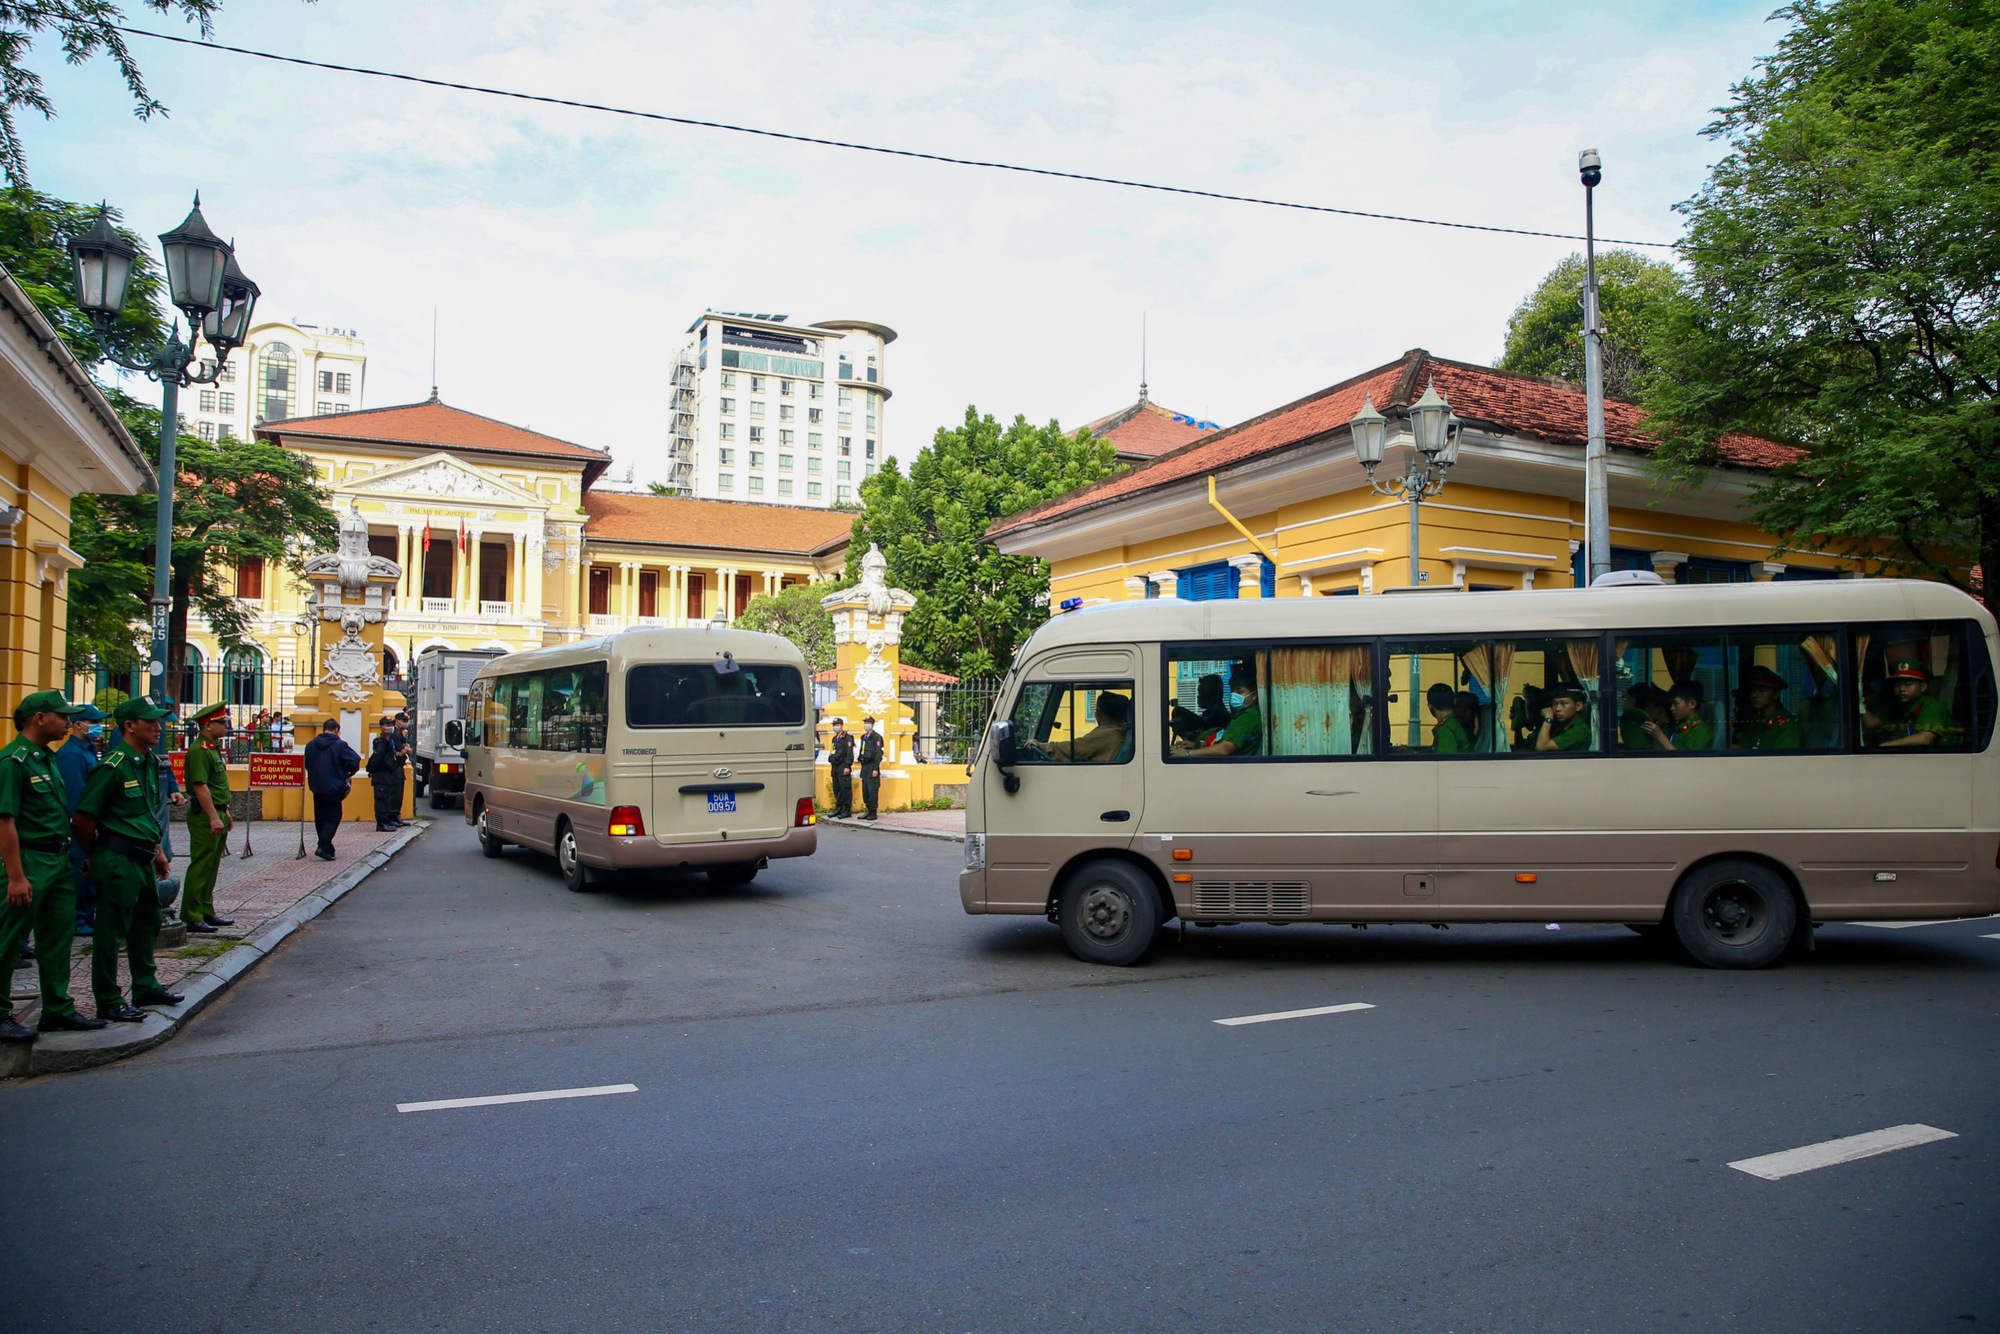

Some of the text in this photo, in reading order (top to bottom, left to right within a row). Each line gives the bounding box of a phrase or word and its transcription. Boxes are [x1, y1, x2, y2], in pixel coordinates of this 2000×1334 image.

[152, 605, 165, 616] 13
[152, 617, 166, 628] 14
[151, 629, 166, 641] 15
[713, 791, 730, 802] 50A
[708, 801, 735, 812] 009.57
